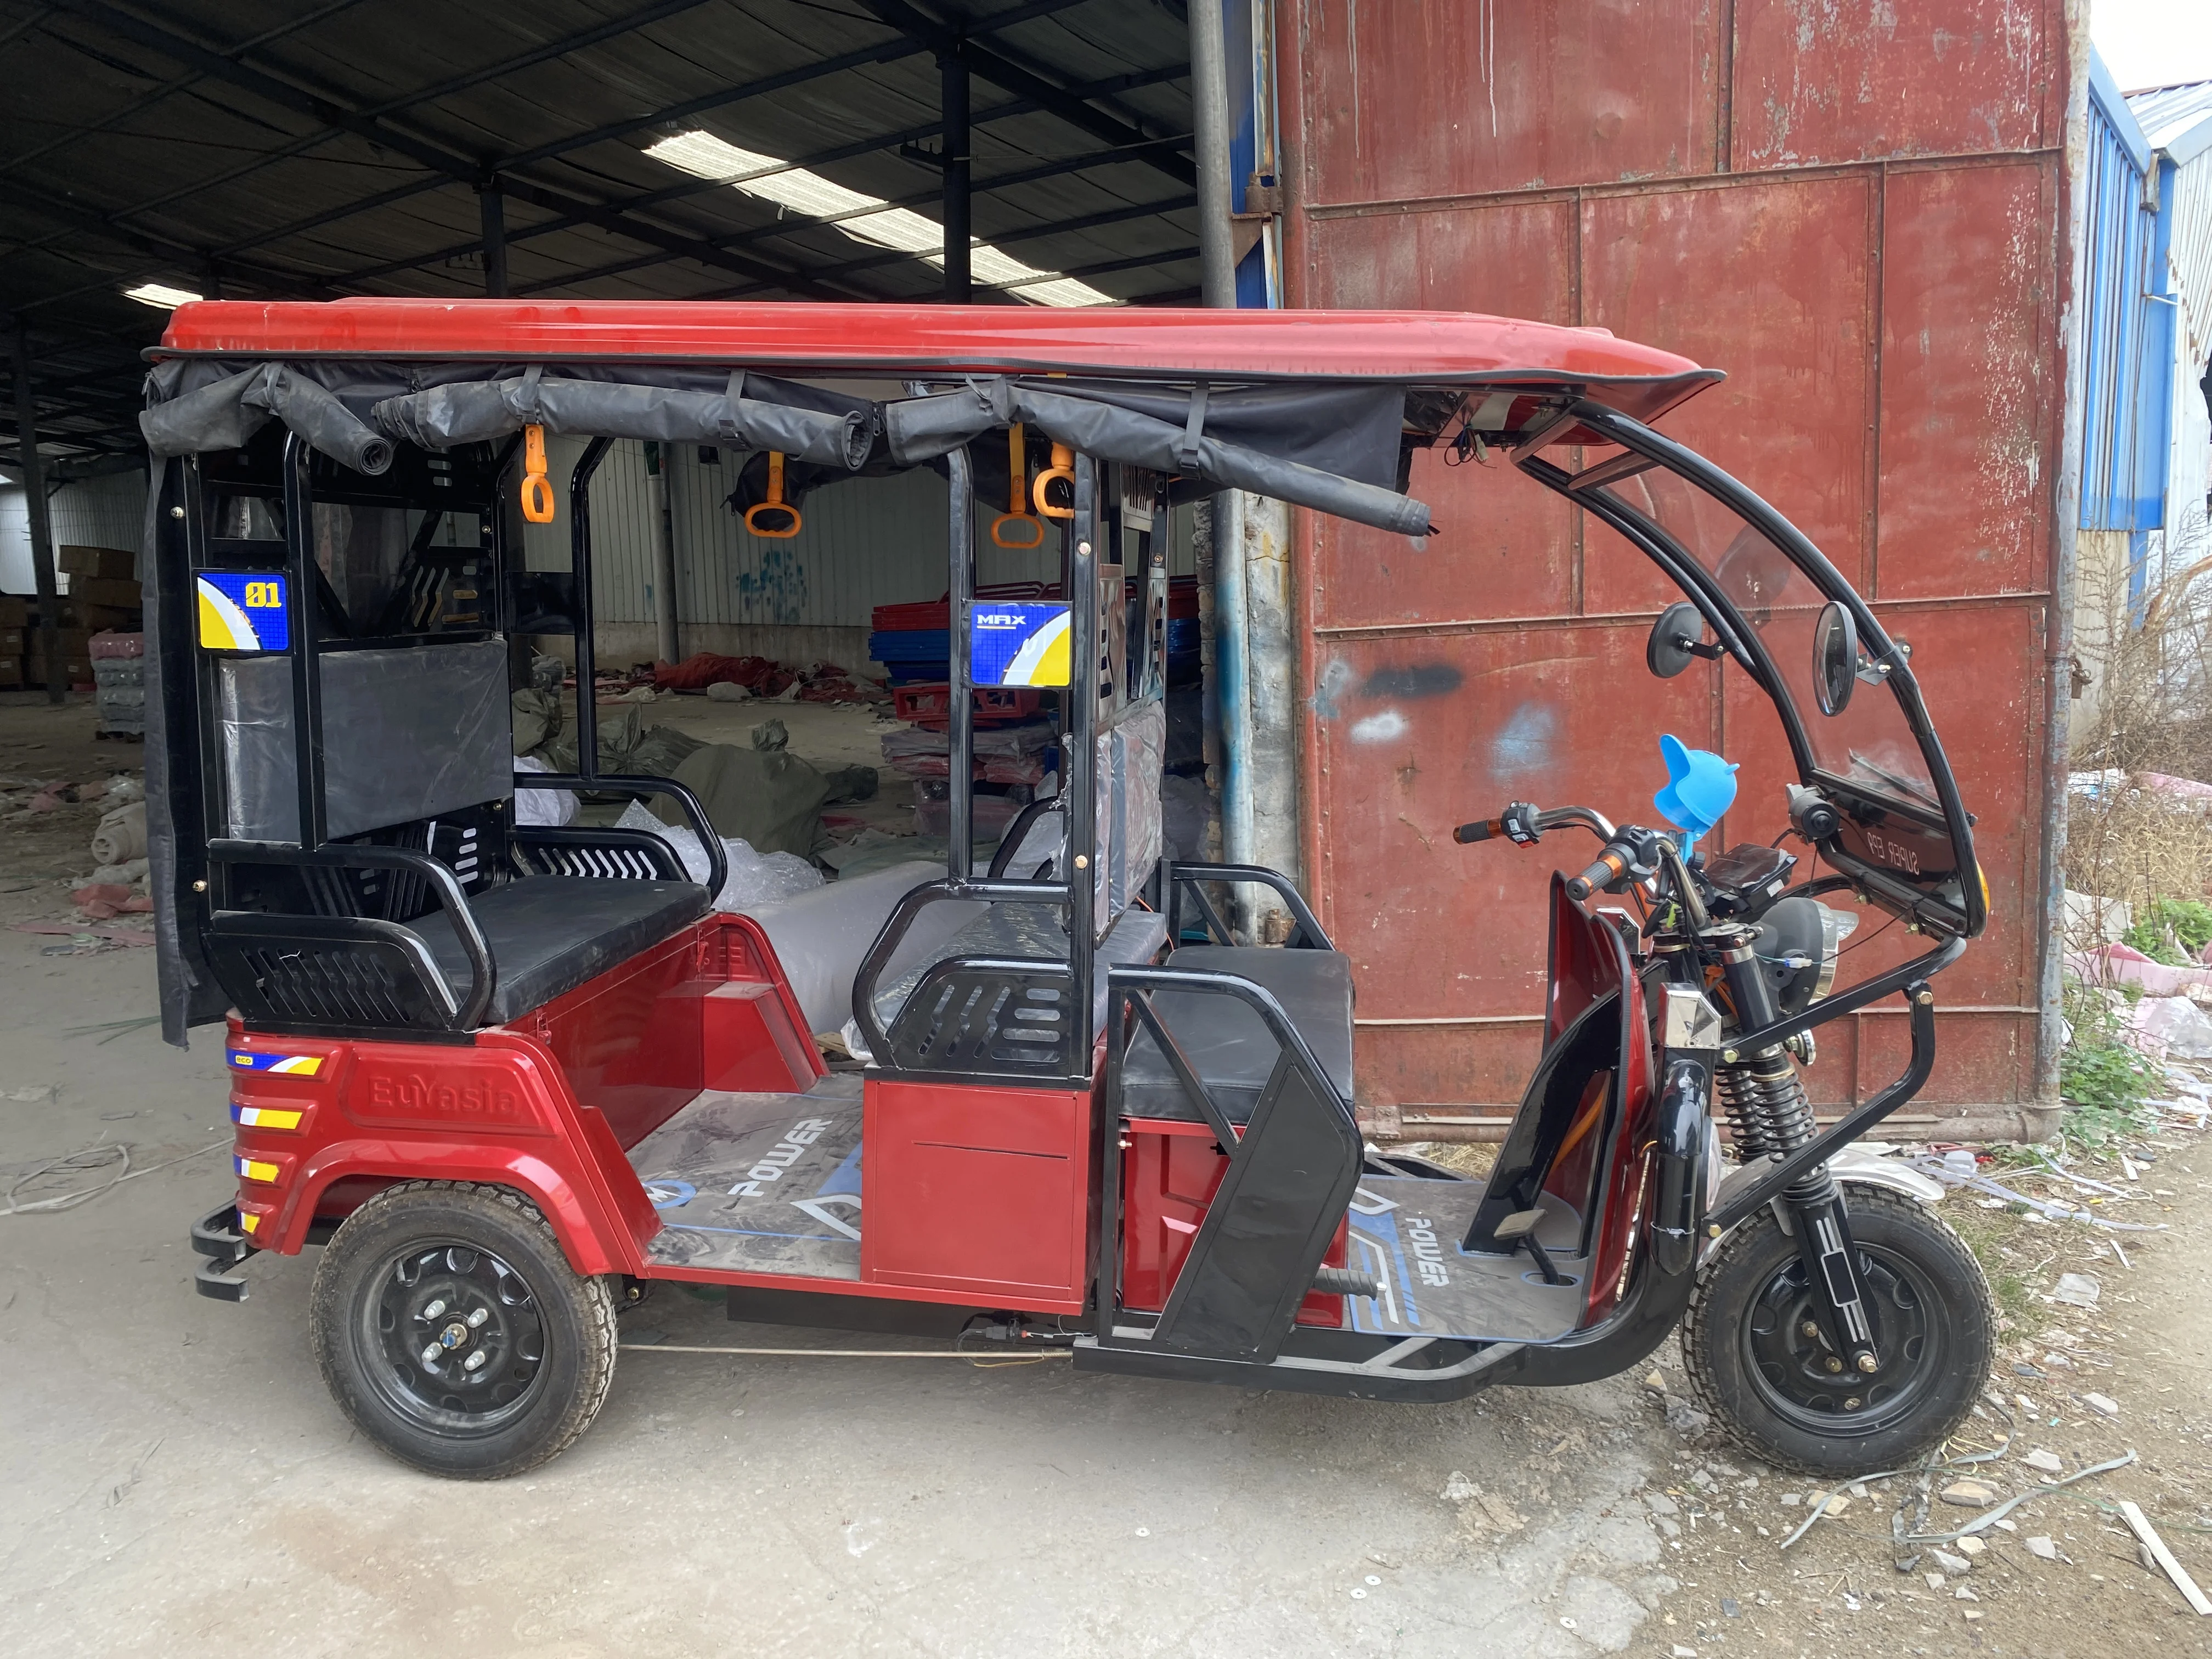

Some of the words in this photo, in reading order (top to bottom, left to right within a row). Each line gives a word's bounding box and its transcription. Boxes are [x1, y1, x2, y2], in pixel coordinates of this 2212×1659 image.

[245, 582, 282, 608] 01
[977, 614, 1027, 625] MAX
[727, 1118, 833, 1197] POWER
[1405, 1217, 1450, 1287] POWER
